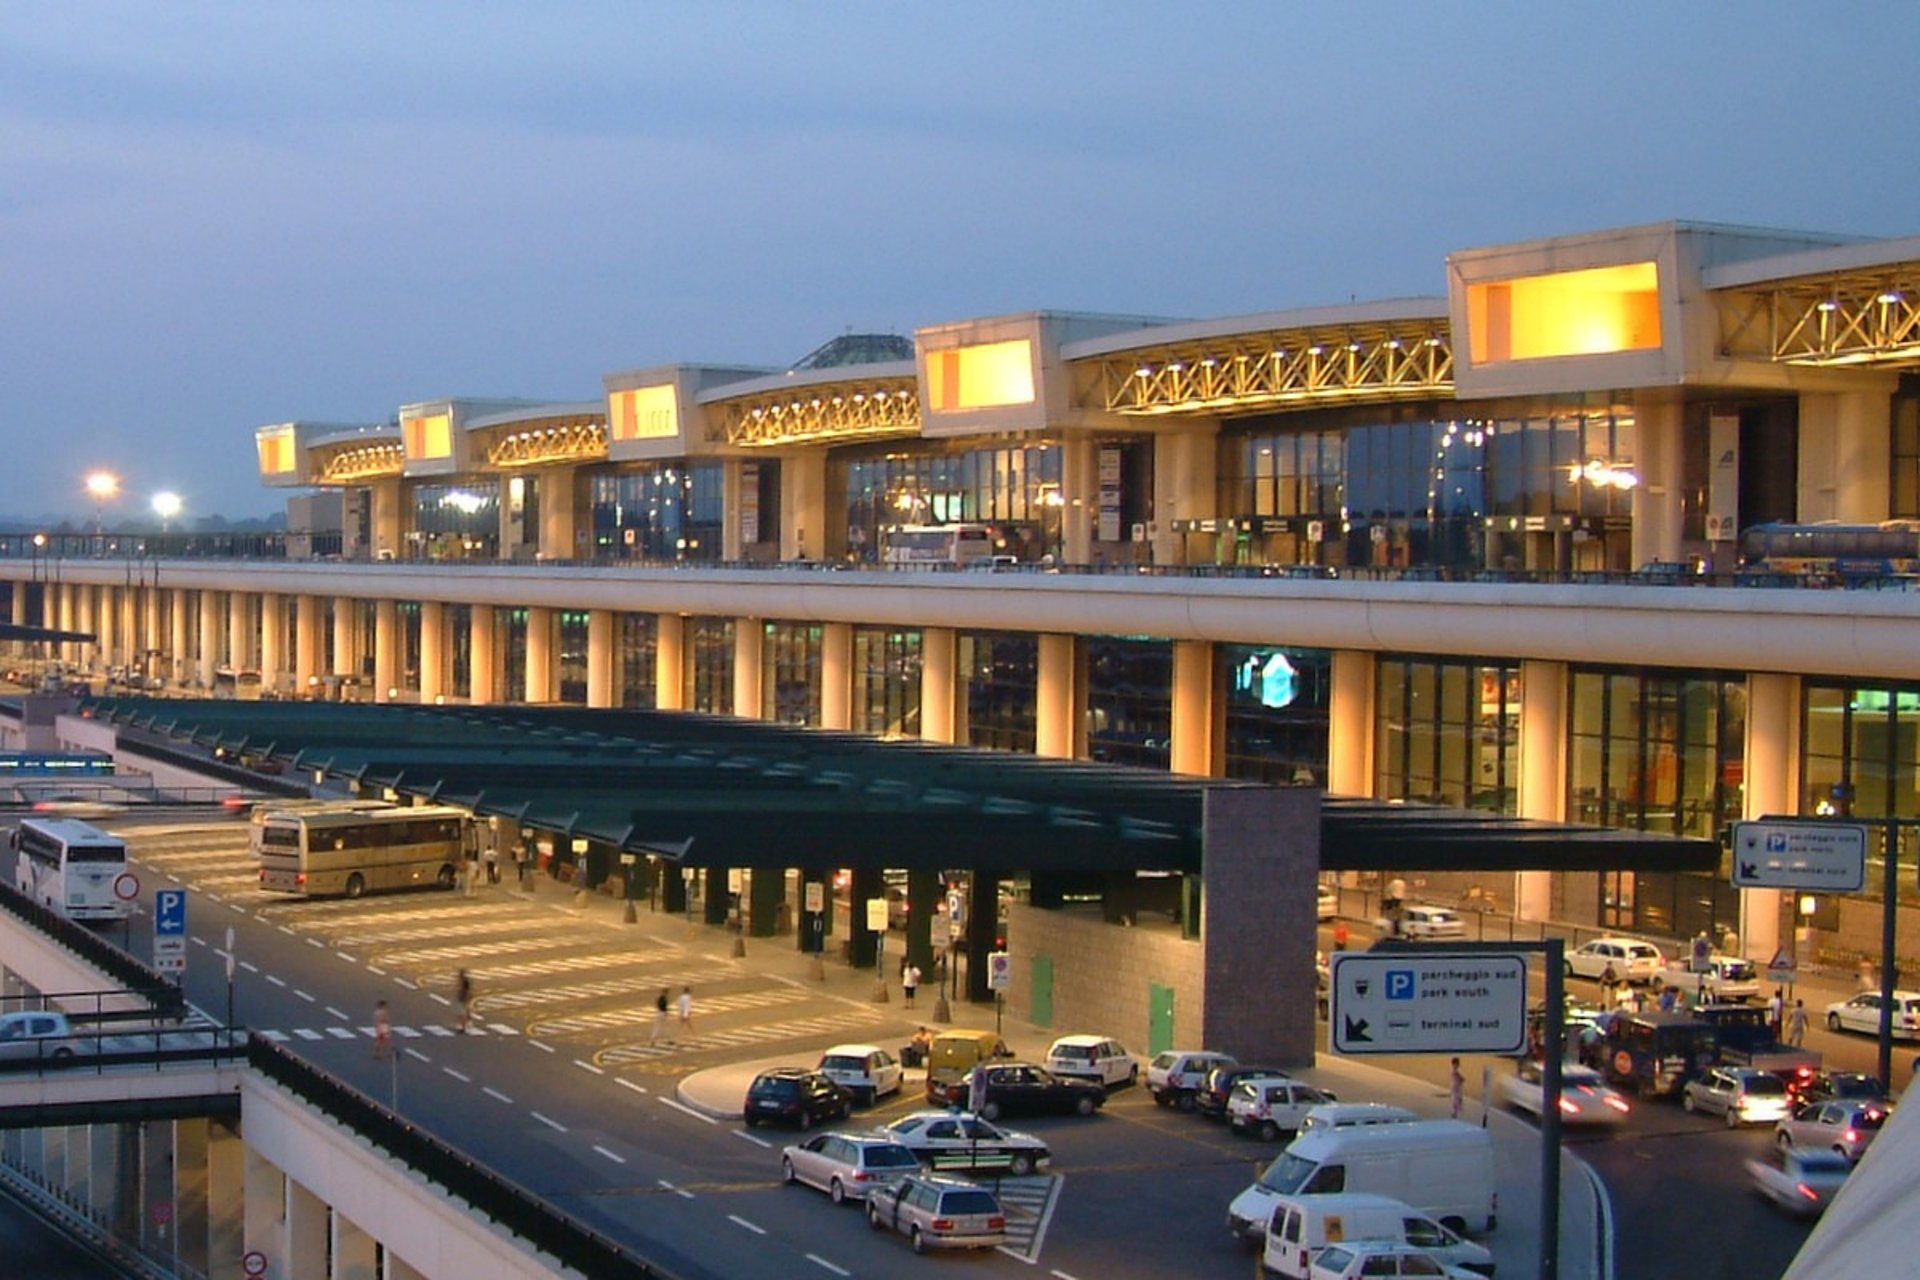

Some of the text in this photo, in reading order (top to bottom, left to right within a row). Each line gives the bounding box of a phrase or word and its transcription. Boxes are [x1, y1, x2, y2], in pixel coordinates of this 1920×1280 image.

[163, 893, 178, 915] P
[1421, 970, 1516, 981] parcheggio sud
[1391, 974, 1409, 997] P
[1421, 987, 1490, 998] park south
[1421, 1018, 1499, 1029] terminal sud
